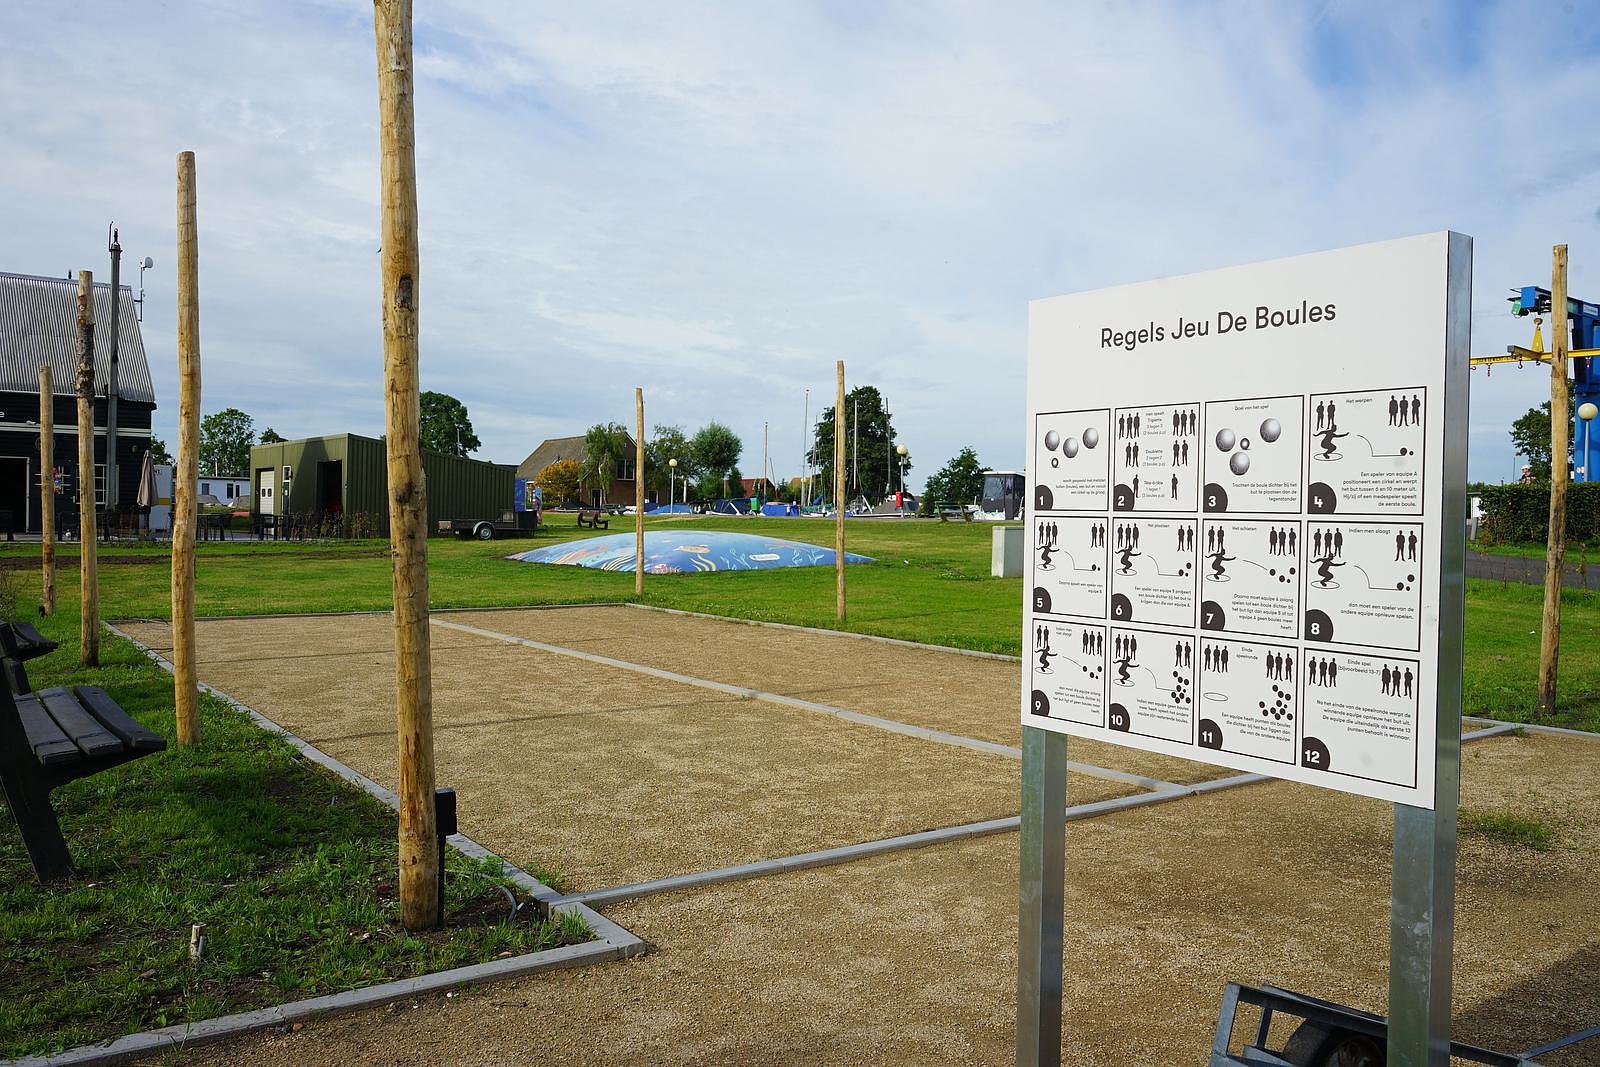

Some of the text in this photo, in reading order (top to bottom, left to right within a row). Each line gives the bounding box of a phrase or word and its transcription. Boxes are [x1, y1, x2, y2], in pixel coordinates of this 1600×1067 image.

[1101, 300, 1336, 351] Regels Jeu De Boules
[1040, 495, 1044, 506] 1
[1118, 495, 1125, 507] 2
[1208, 495, 1216, 507] 3
[1314, 495, 1323, 508] 4
[1037, 597, 1043, 608] 5
[1116, 604, 1122, 616] 6
[1206, 613, 1214, 625] 7
[1311, 622, 1320, 635] 8
[1035, 700, 1041, 711] 9
[1111, 714, 1123, 726] 10
[1202, 730, 1213, 743] 11
[1305, 749, 1320, 764] 12
